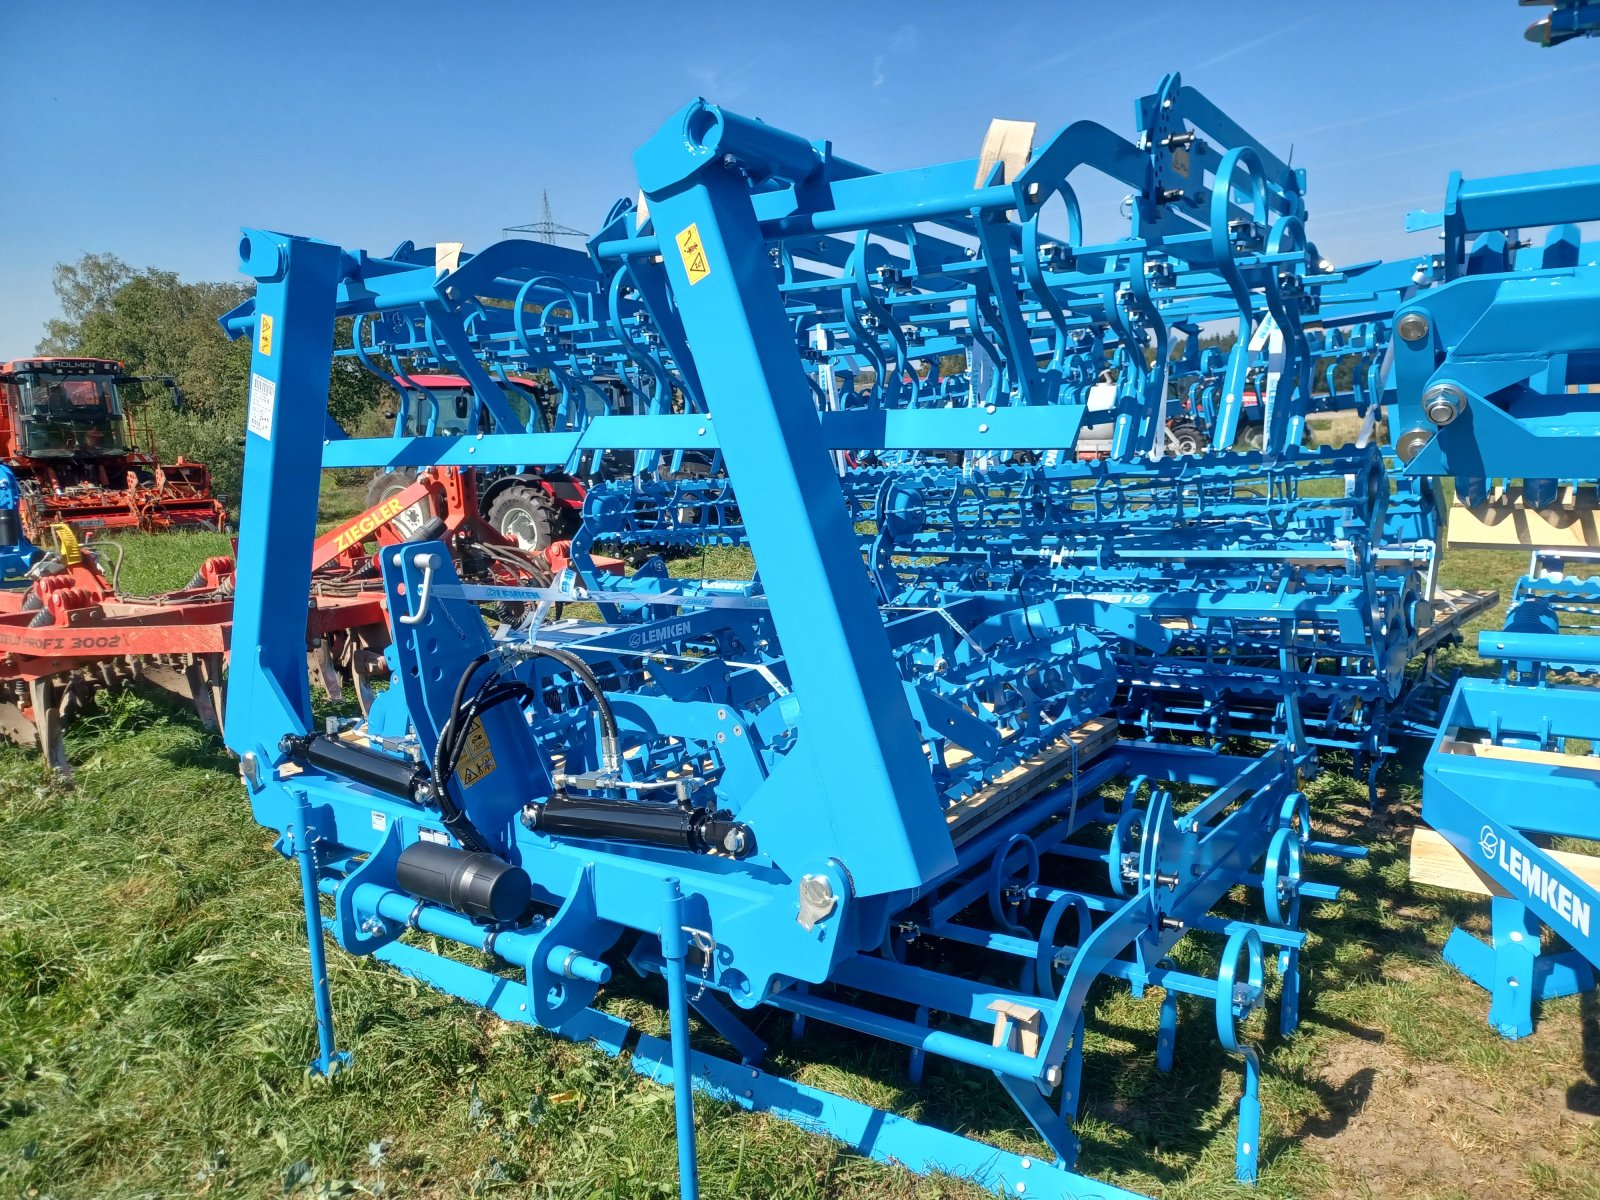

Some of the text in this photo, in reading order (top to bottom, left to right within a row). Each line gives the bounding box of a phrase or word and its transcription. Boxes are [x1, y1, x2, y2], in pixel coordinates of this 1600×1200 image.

[333, 498, 404, 552] ZIEGLER
[494, 588, 541, 600] LEMKEN
[70, 634, 121, 649] 3002
[641, 620, 692, 645] LEMKEN
[1499, 838, 1591, 938] LEMKEN
